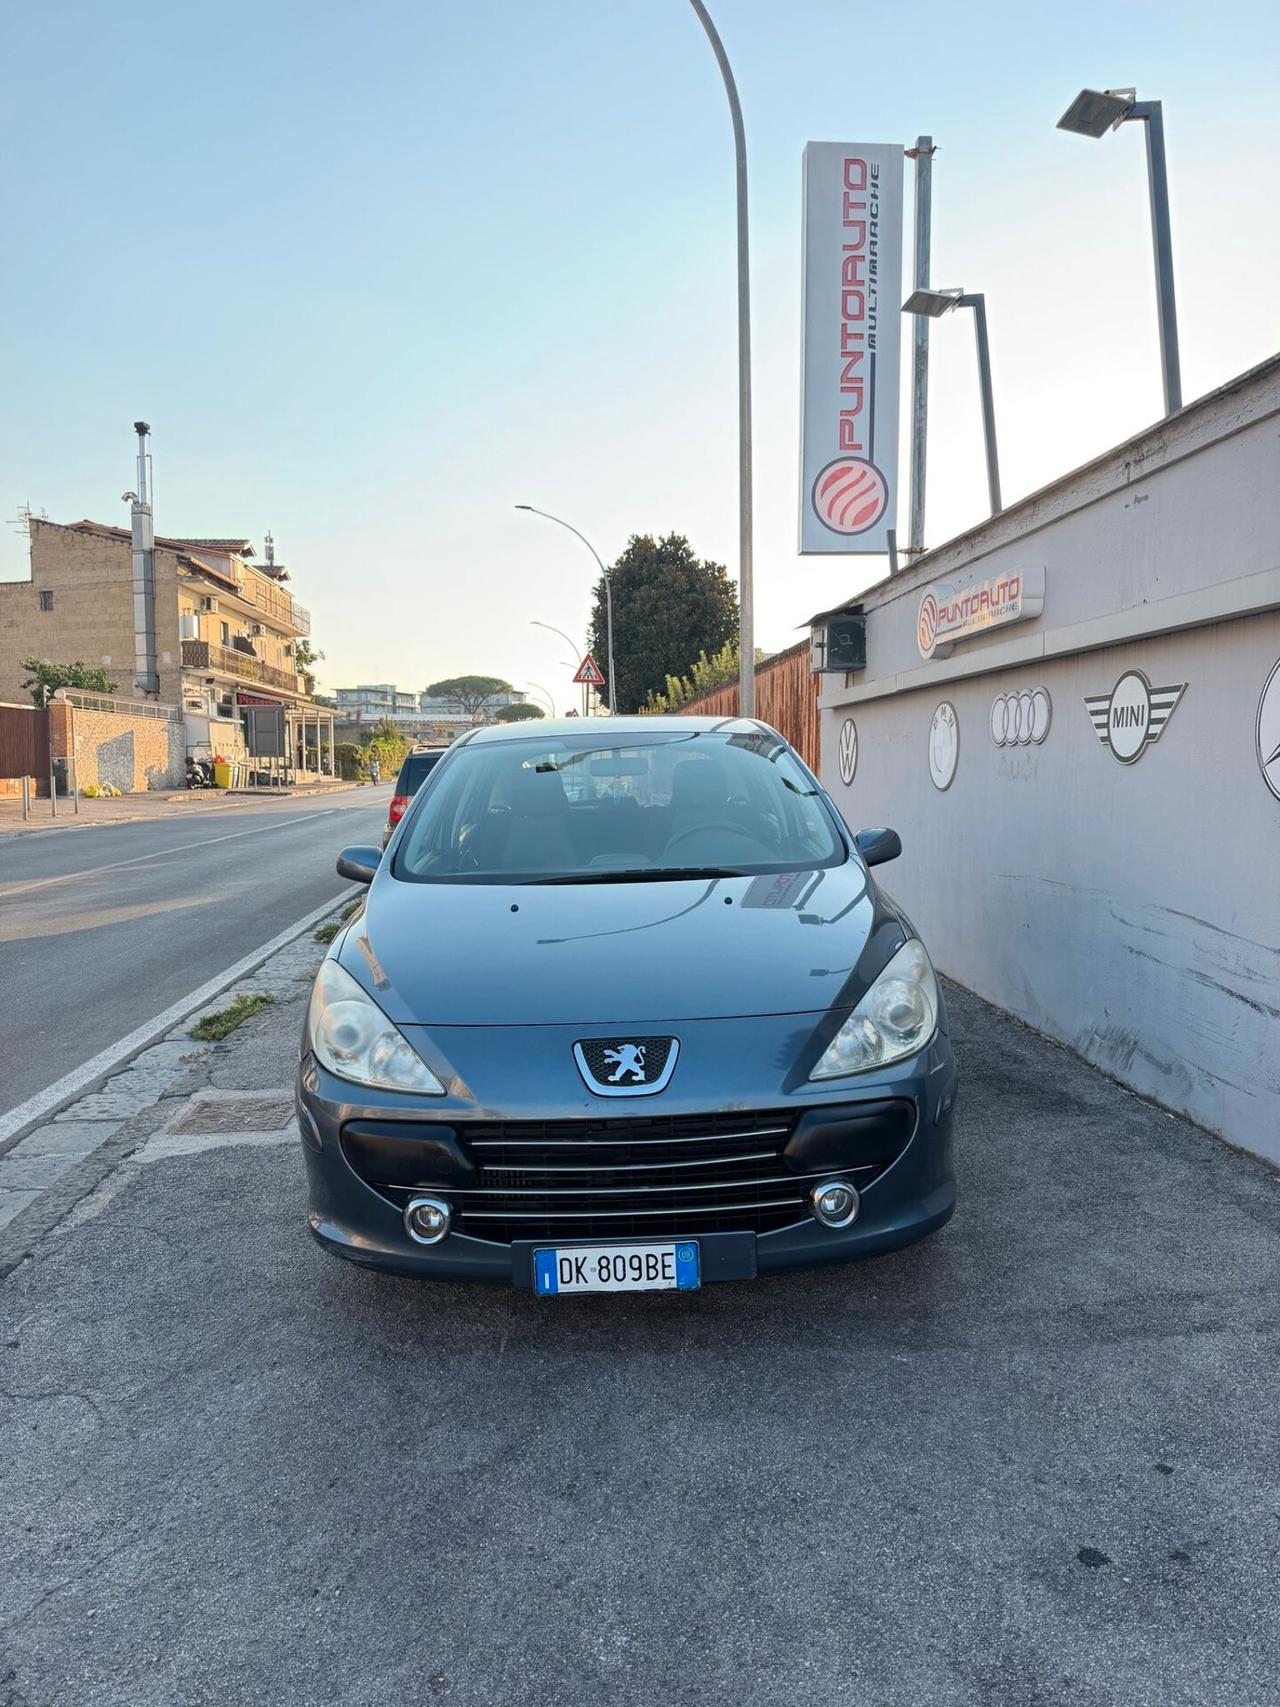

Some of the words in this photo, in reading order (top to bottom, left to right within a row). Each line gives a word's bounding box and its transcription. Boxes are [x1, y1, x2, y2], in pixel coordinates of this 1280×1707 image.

[868, 162, 880, 350] MULTIMARCHE
[840, 158, 867, 451] PUNTOAUTO
[938, 577, 1020, 627] PUNTOAUTO
[1112, 704, 1145, 728] MINI
[559, 1256, 588, 1284] DK
[597, 1252, 675, 1283] 809BE
